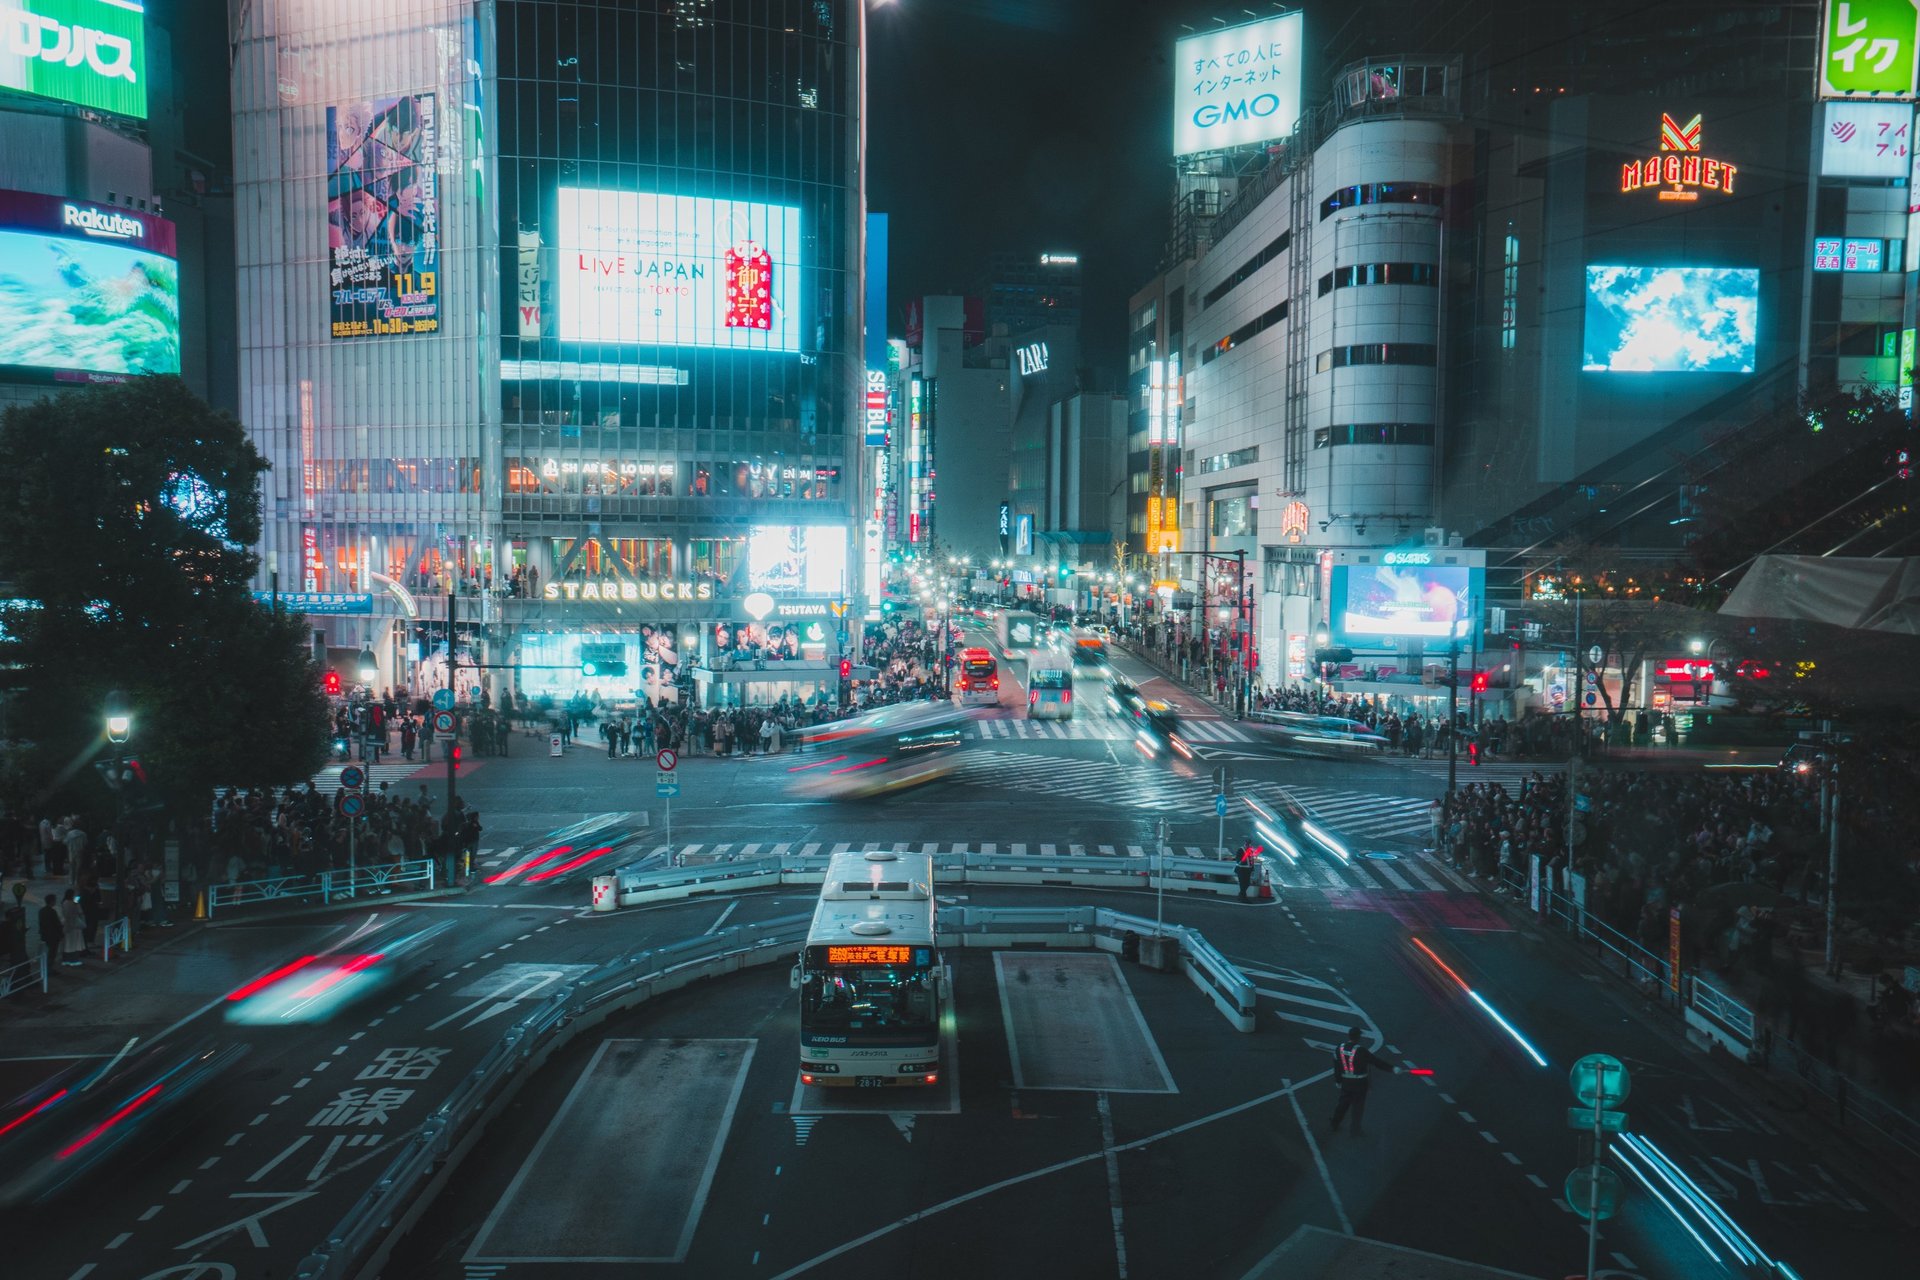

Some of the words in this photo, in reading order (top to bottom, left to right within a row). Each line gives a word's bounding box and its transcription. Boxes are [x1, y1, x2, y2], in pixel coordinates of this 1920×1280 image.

[0, 9, 137, 84] ロンパス
[1194, 43, 1282, 75] すべての人に
[1832, 38, 1899, 73] イク
[1194, 64, 1281, 95] インターネット
[1193, 93, 1280, 128] GMO
[1621, 156, 1737, 193] MAGNET
[64, 204, 143, 238] Rakuten
[580, 254, 625, 276] LIVE
[634, 260, 704, 280] JAPAN
[333, 287, 387, 304] ブルーロック
[650, 285, 688, 296] TOKYO
[737, 265, 759, 315] 御守
[1016, 342, 1049, 375] ZARA
[867, 370, 886, 435] SEIBU
[561, 463, 610, 474] SHARE
[621, 464, 674, 476] LOUNGE
[1000, 506, 1008, 535] ZARA
[544, 582, 712, 600] STARBUCKS
[778, 604, 827, 616] TSUTAYA
